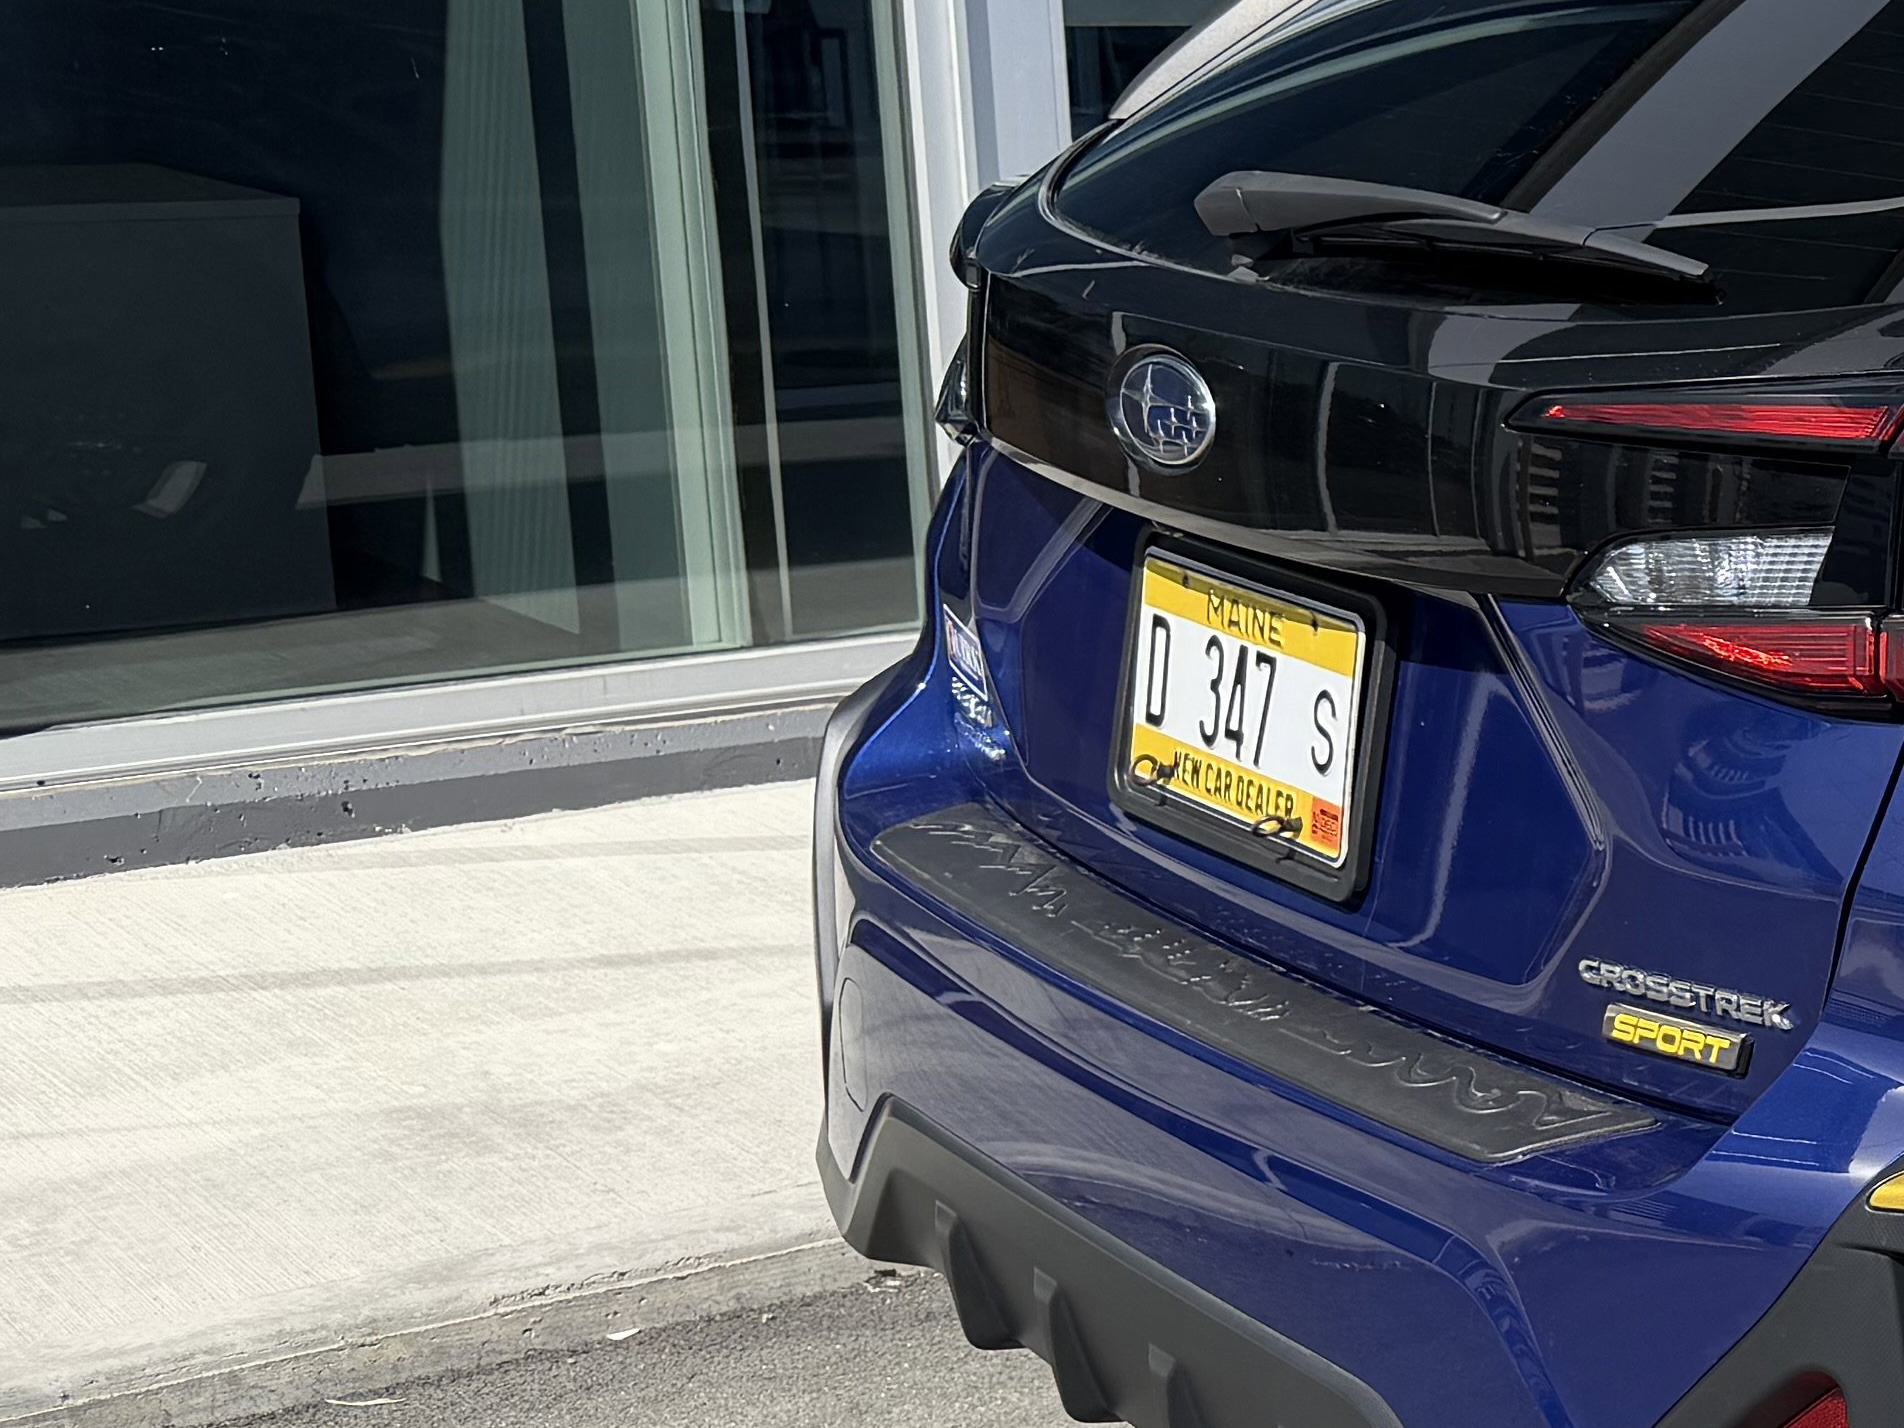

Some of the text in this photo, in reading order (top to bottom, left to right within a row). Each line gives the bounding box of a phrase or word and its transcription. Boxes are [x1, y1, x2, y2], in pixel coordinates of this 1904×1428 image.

[1207, 590, 1285, 647] MAINE
[1145, 613, 1338, 775] D 347 S
[1173, 748, 1295, 820] NEW CAR DEALER
[1578, 956, 1794, 1031] CROSSTREK
[1611, 1013, 1732, 1064] SPORT
